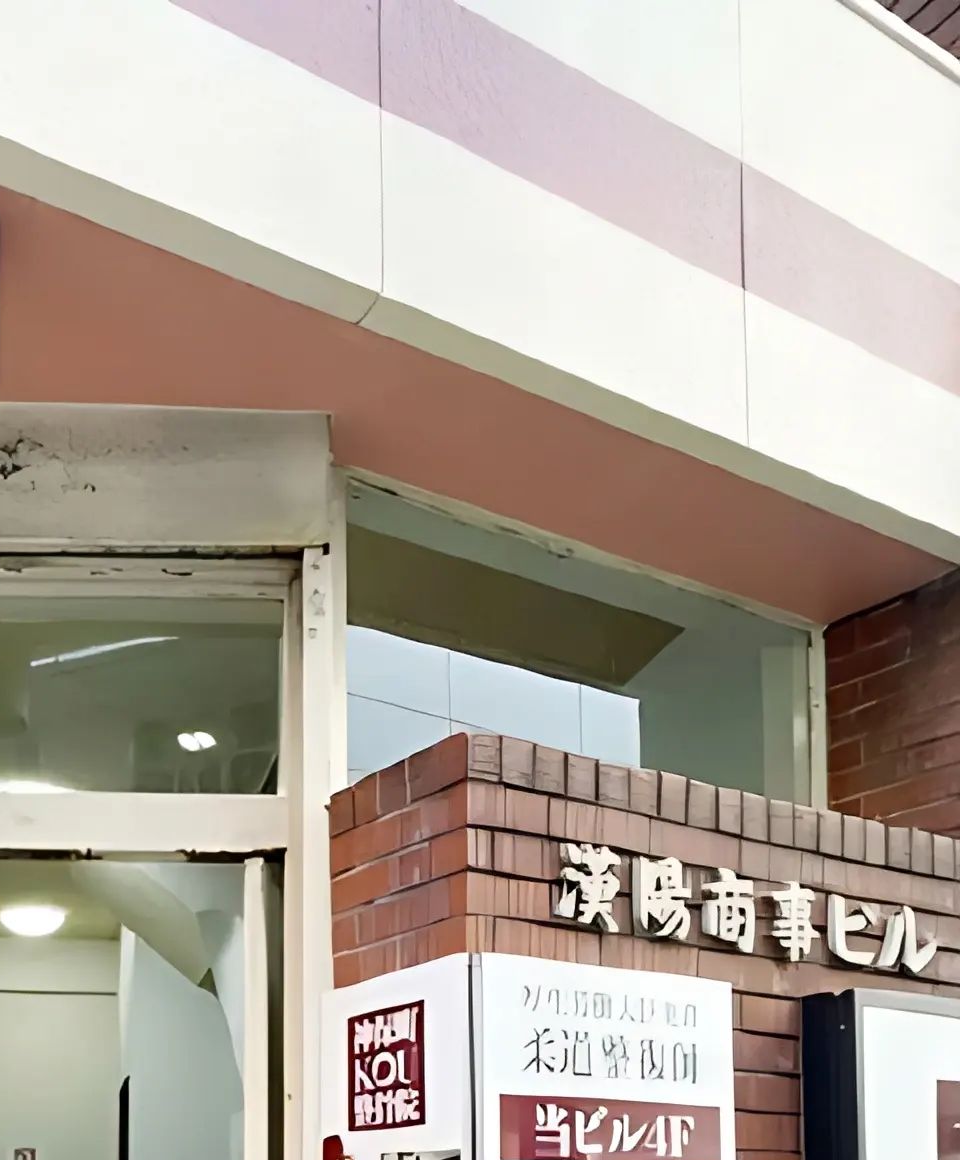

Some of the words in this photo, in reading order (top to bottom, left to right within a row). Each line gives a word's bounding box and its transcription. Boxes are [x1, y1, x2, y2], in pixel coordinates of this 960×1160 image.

[553, 842, 937, 975] 漢陽商事ビル
[535, 1103, 695, 1159] 当ビル4F
